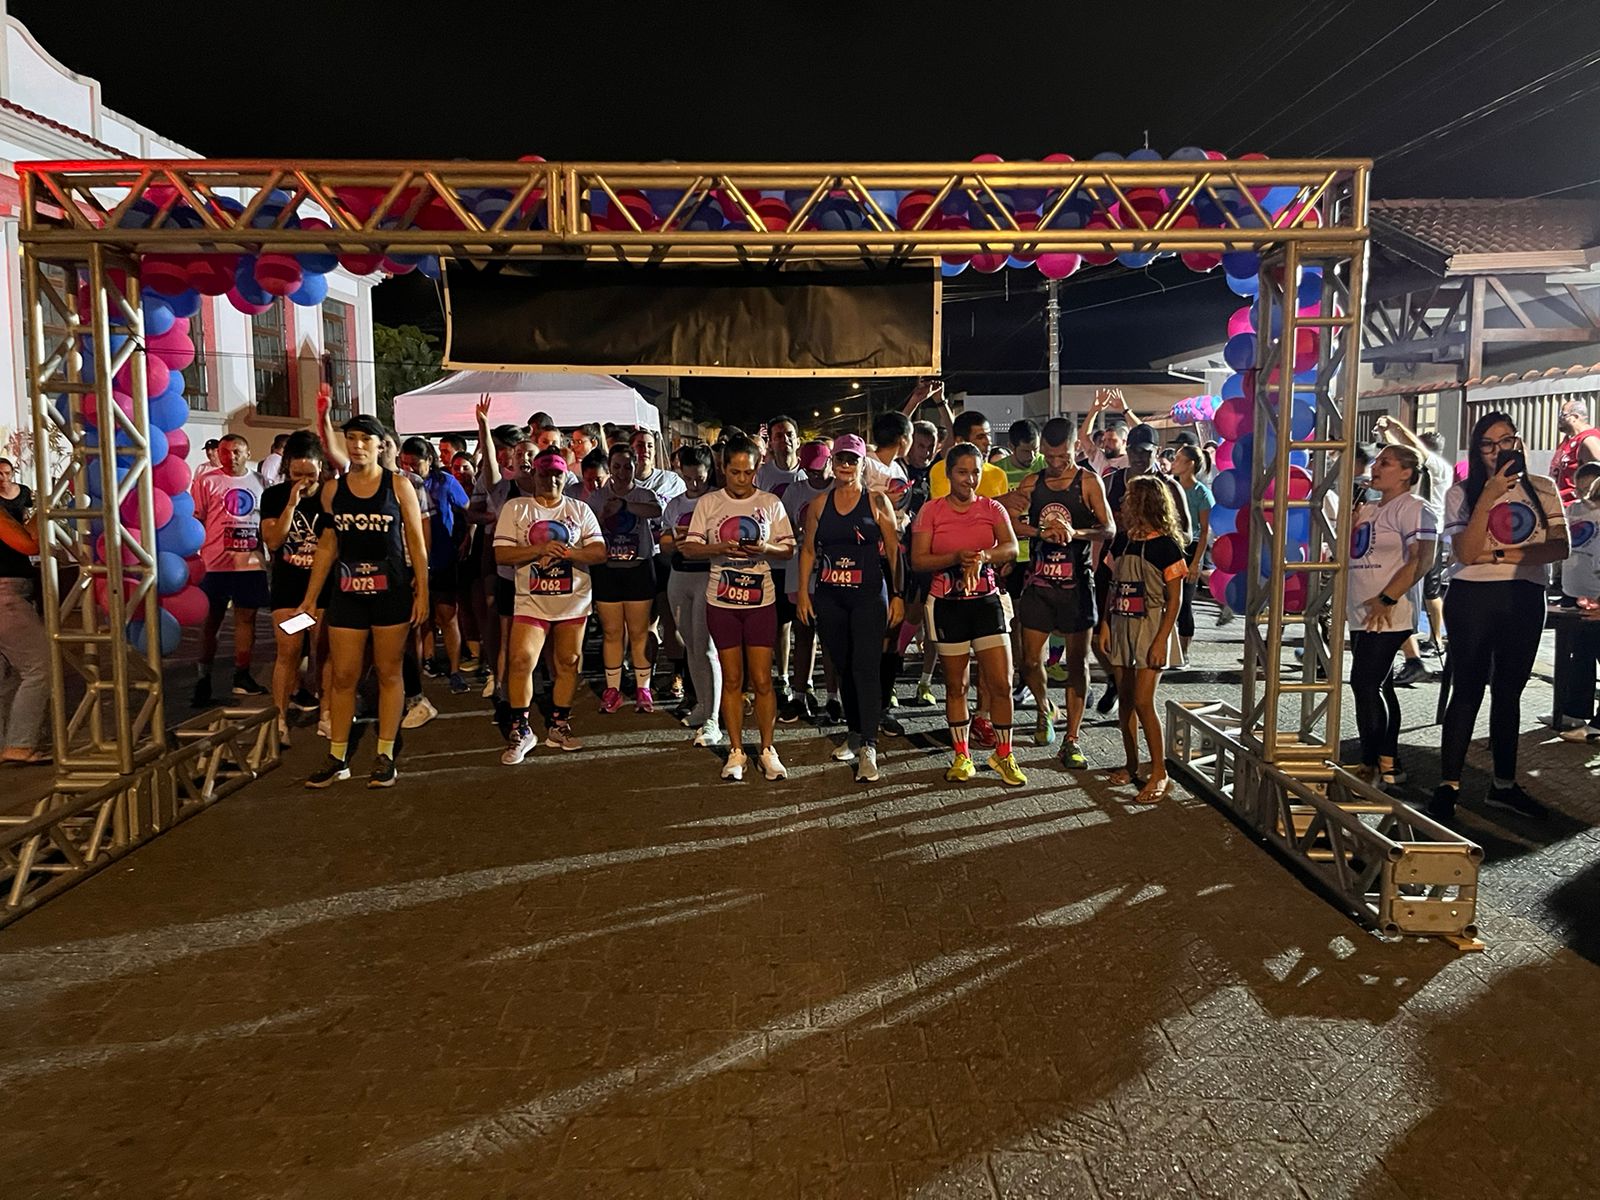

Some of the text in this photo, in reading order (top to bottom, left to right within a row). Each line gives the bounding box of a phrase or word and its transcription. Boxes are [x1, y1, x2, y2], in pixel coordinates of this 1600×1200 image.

[333, 513, 394, 533] SPORT
[233, 539, 249, 549] 012
[831, 570, 852, 583] 043
[1043, 564, 1062, 577] 074
[352, 577, 375, 591] 073
[540, 579, 561, 591] 062
[728, 586, 750, 601] 058
